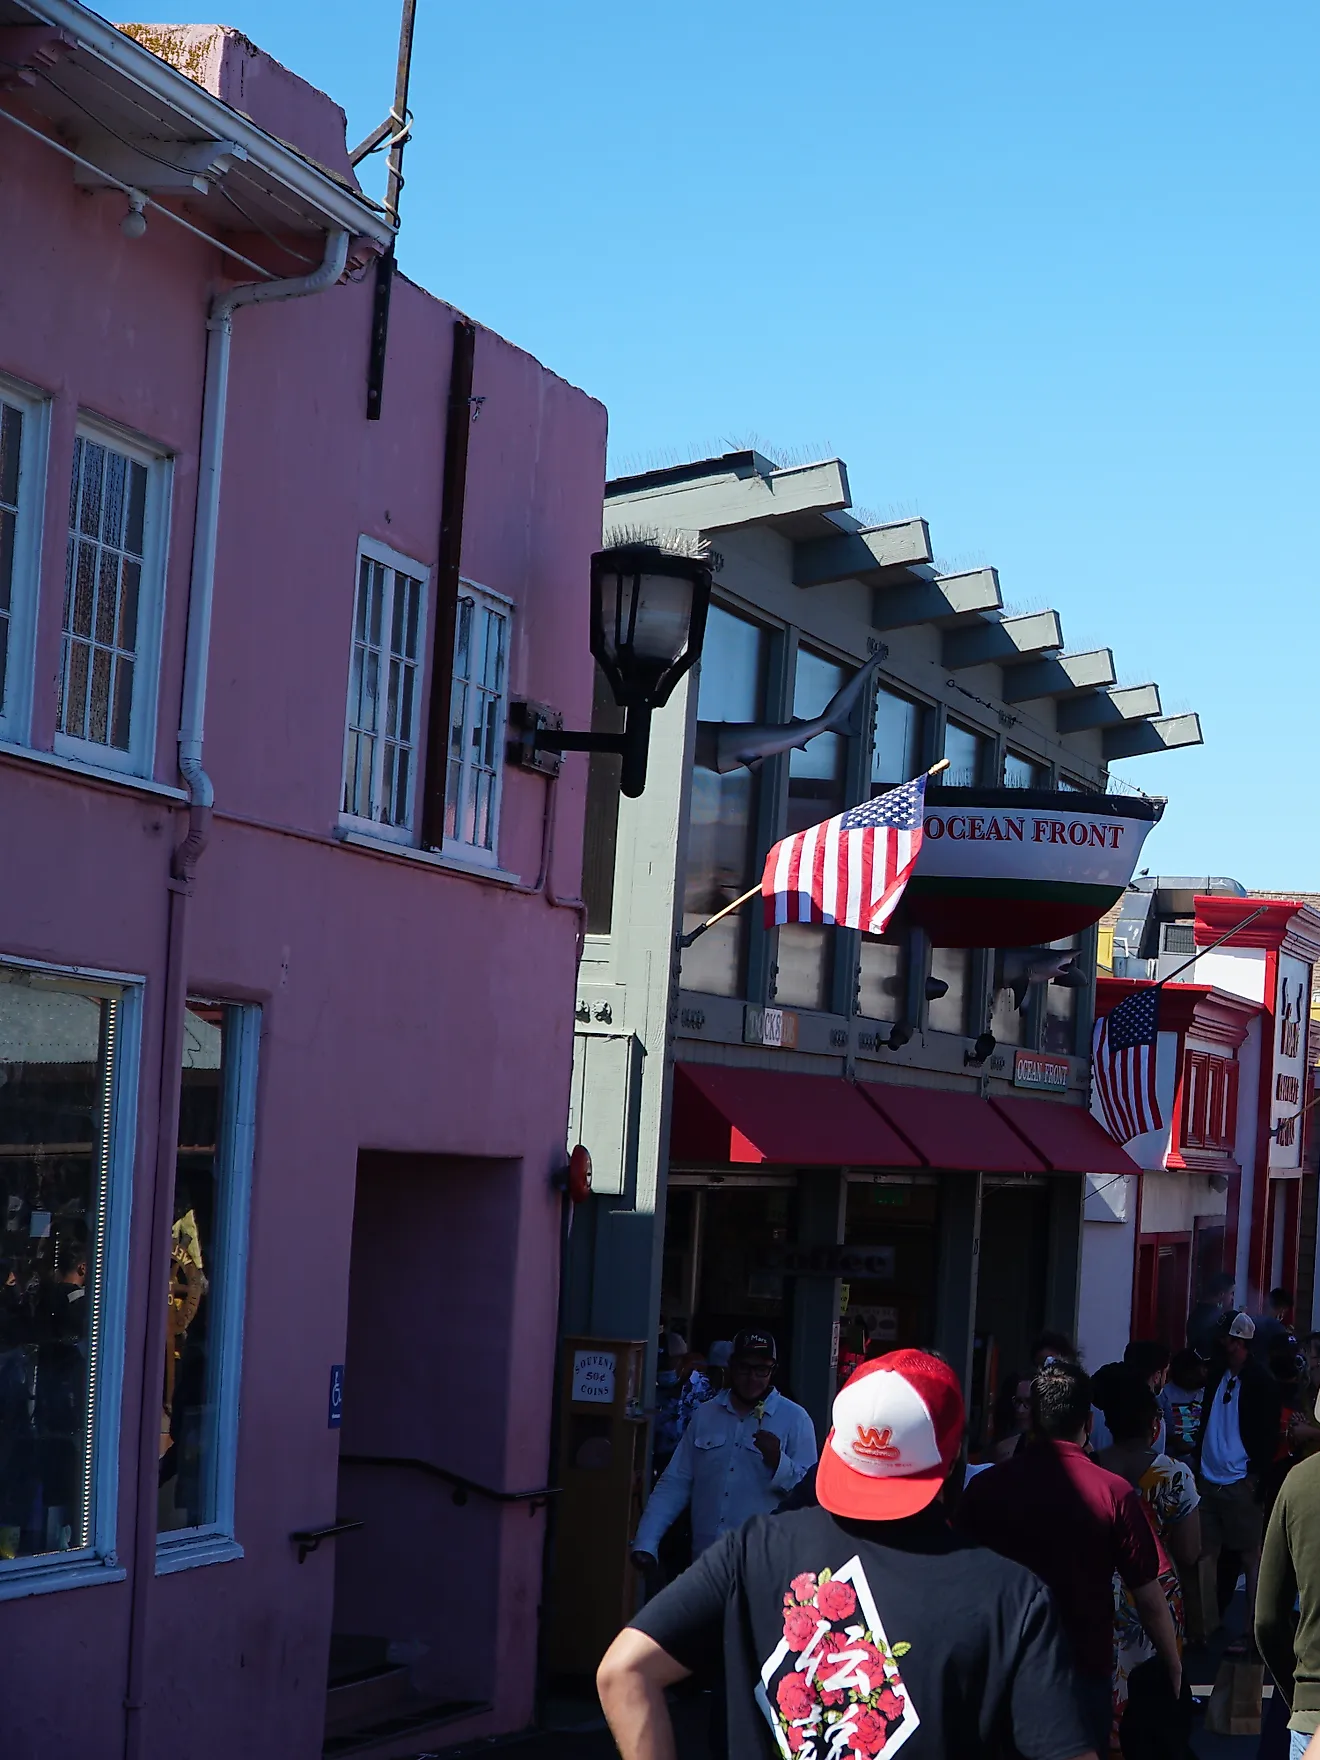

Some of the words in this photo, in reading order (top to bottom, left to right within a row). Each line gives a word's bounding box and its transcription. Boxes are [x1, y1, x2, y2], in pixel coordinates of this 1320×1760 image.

[923, 815, 1025, 841] OCEAN
[1032, 817, 1124, 849] FRONT
[1016, 1059, 1043, 1082] OCEAN
[1044, 1063, 1068, 1085] FRONT
[581, 1384, 609, 1396] COINS
